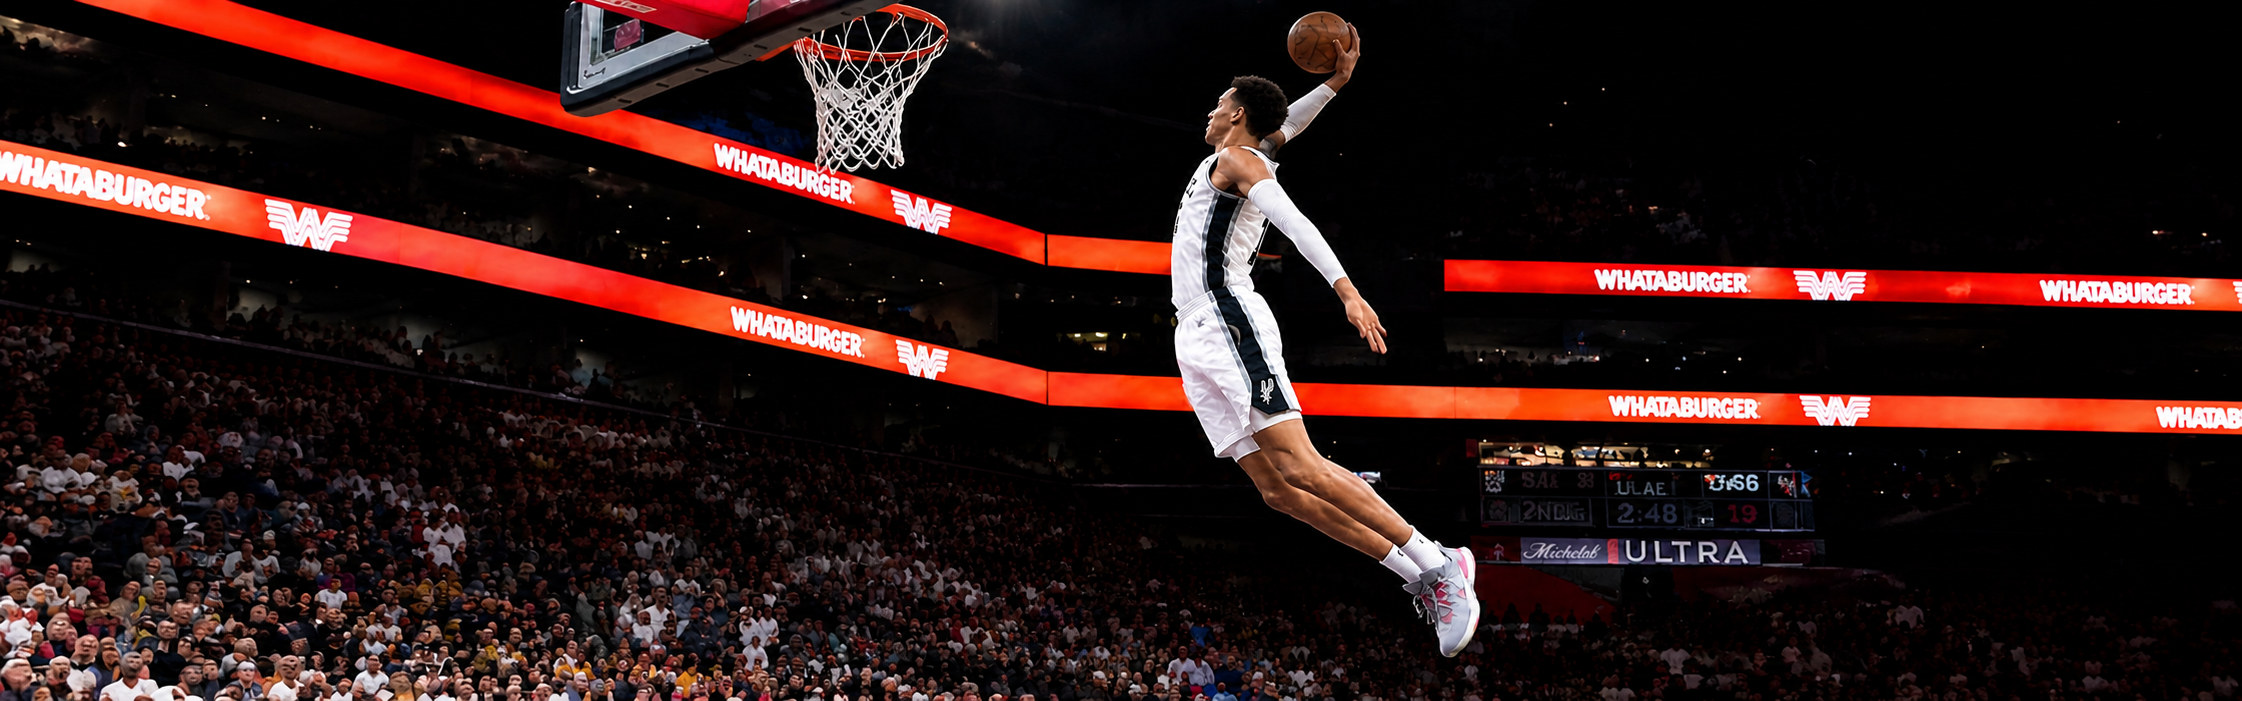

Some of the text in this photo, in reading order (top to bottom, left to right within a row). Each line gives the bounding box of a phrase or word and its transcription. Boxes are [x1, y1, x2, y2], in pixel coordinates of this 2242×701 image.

[714, 143, 854, 204] WHATABURGER
[0, 151, 211, 221] WHATABURGER
[1594, 269, 1751, 293] WHATABURGER
[2039, 279, 2195, 305] WHATABURGER
[730, 306, 865, 358] WHATABURGER
[1608, 396, 1761, 419] WHATABURGER
[2156, 406, 2242, 430] WHATAB
[1617, 502, 1678, 524] 2:48
[1728, 504, 1758, 523] 19
[1625, 540, 1749, 564] ULTRA
